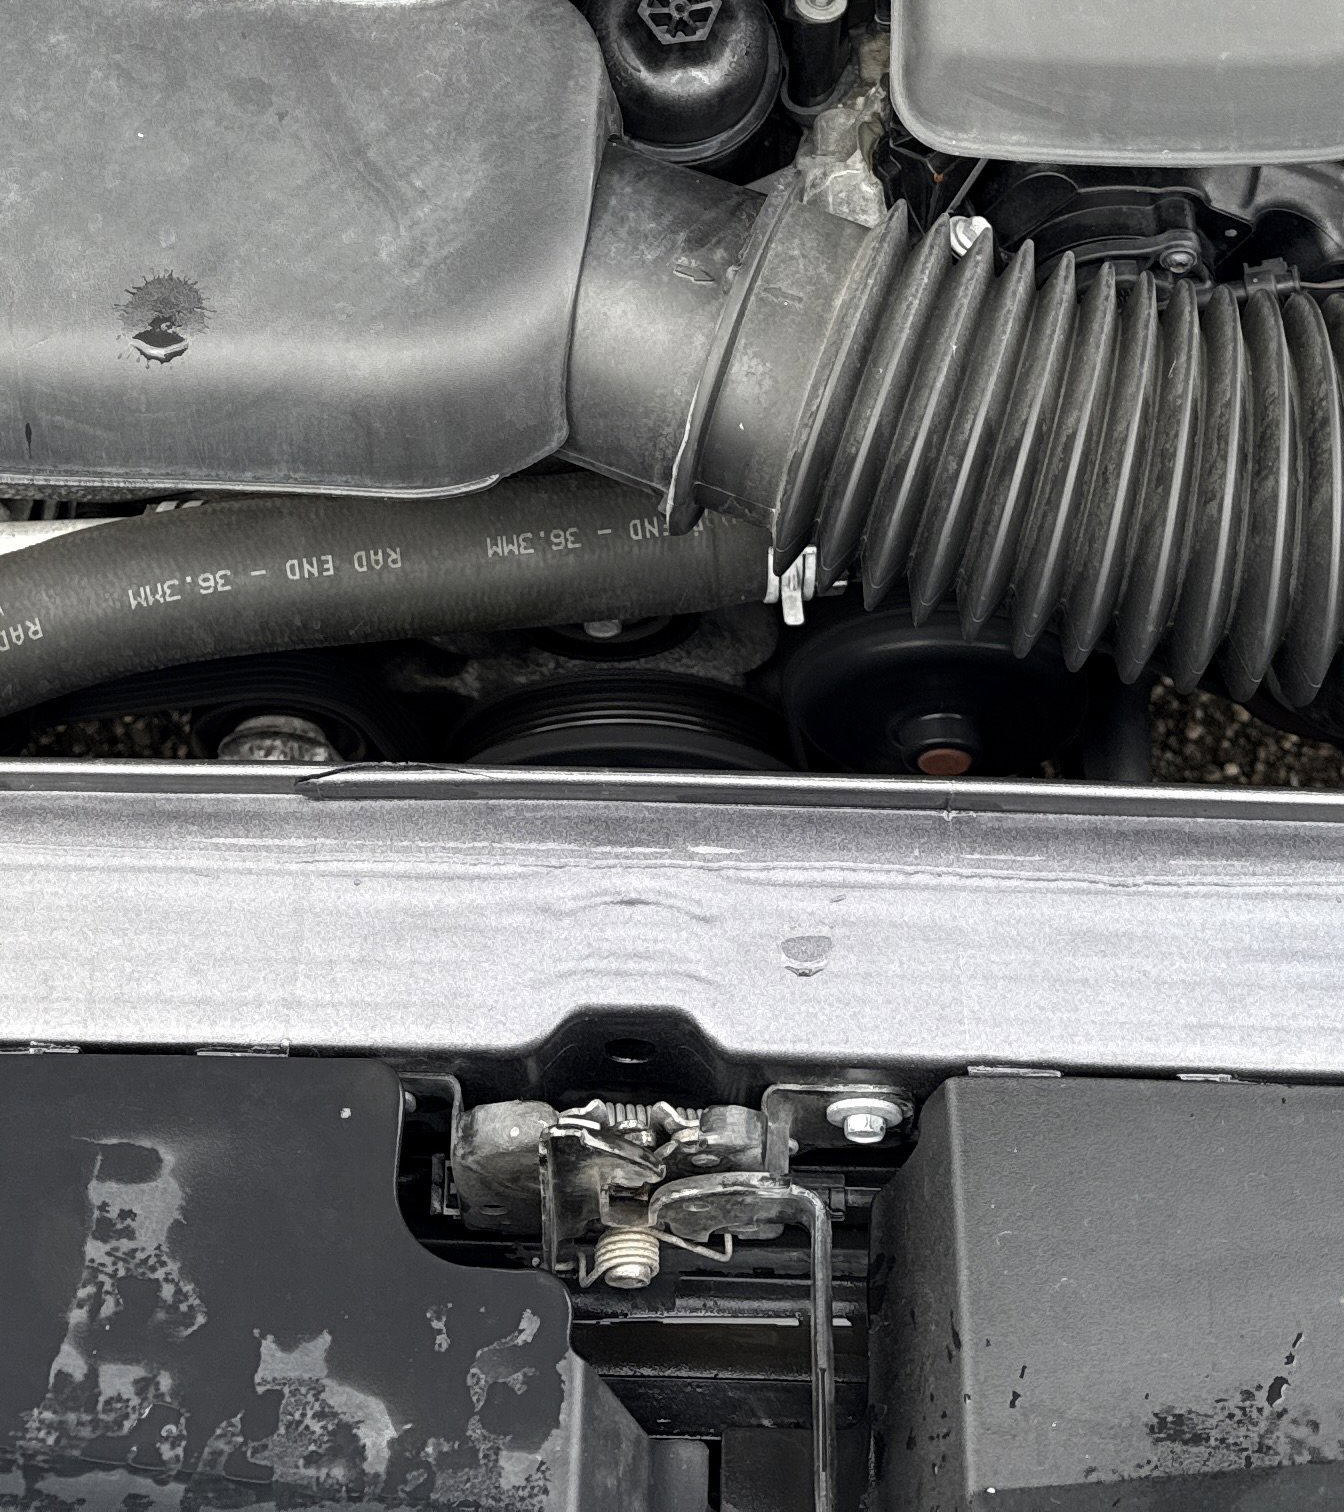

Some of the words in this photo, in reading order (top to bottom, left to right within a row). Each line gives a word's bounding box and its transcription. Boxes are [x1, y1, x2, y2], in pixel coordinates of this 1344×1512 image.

[486, 527, 582, 558] 36.3MM
[285, 554, 335, 580] END
[353, 547, 402, 574] RAD
[128, 568, 233, 610] 36.3MM
